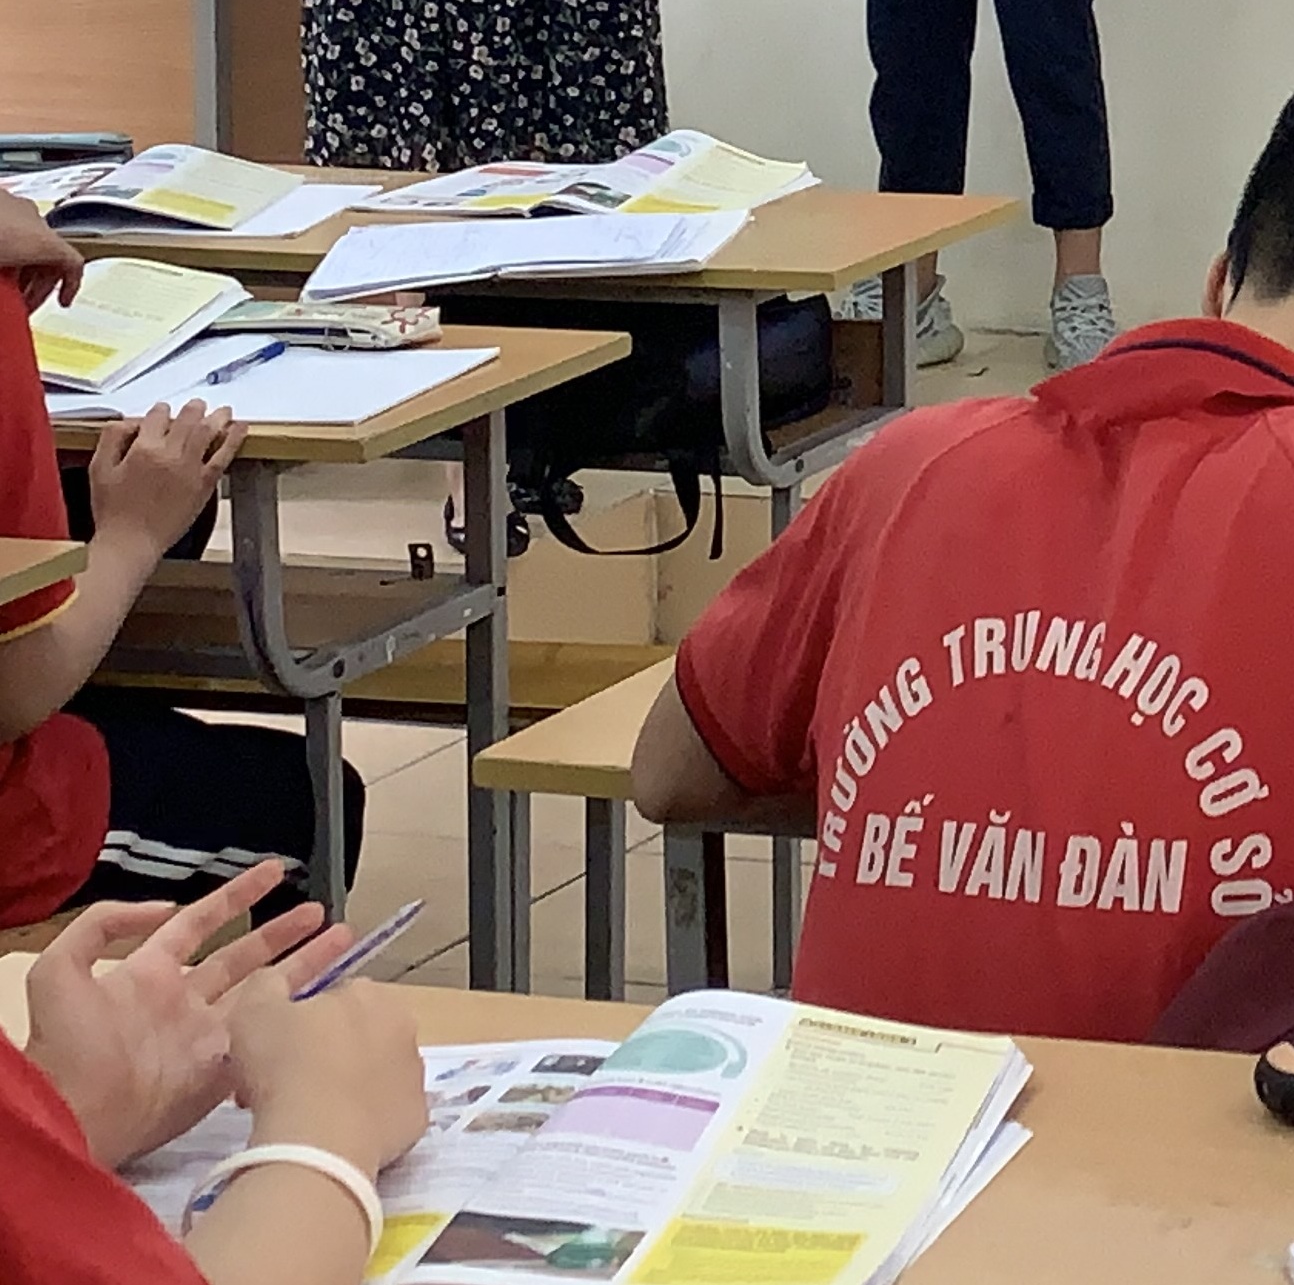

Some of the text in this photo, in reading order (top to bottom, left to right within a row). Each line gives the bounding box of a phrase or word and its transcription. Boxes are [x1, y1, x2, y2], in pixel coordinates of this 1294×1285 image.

[943, 611, 1108, 687] TRUNG
[1102, 633, 1210, 737] HỌC
[1186, 729, 1269, 816] CƠ
[856, 793, 1187, 912] BẾ VĂN ĐÀN
